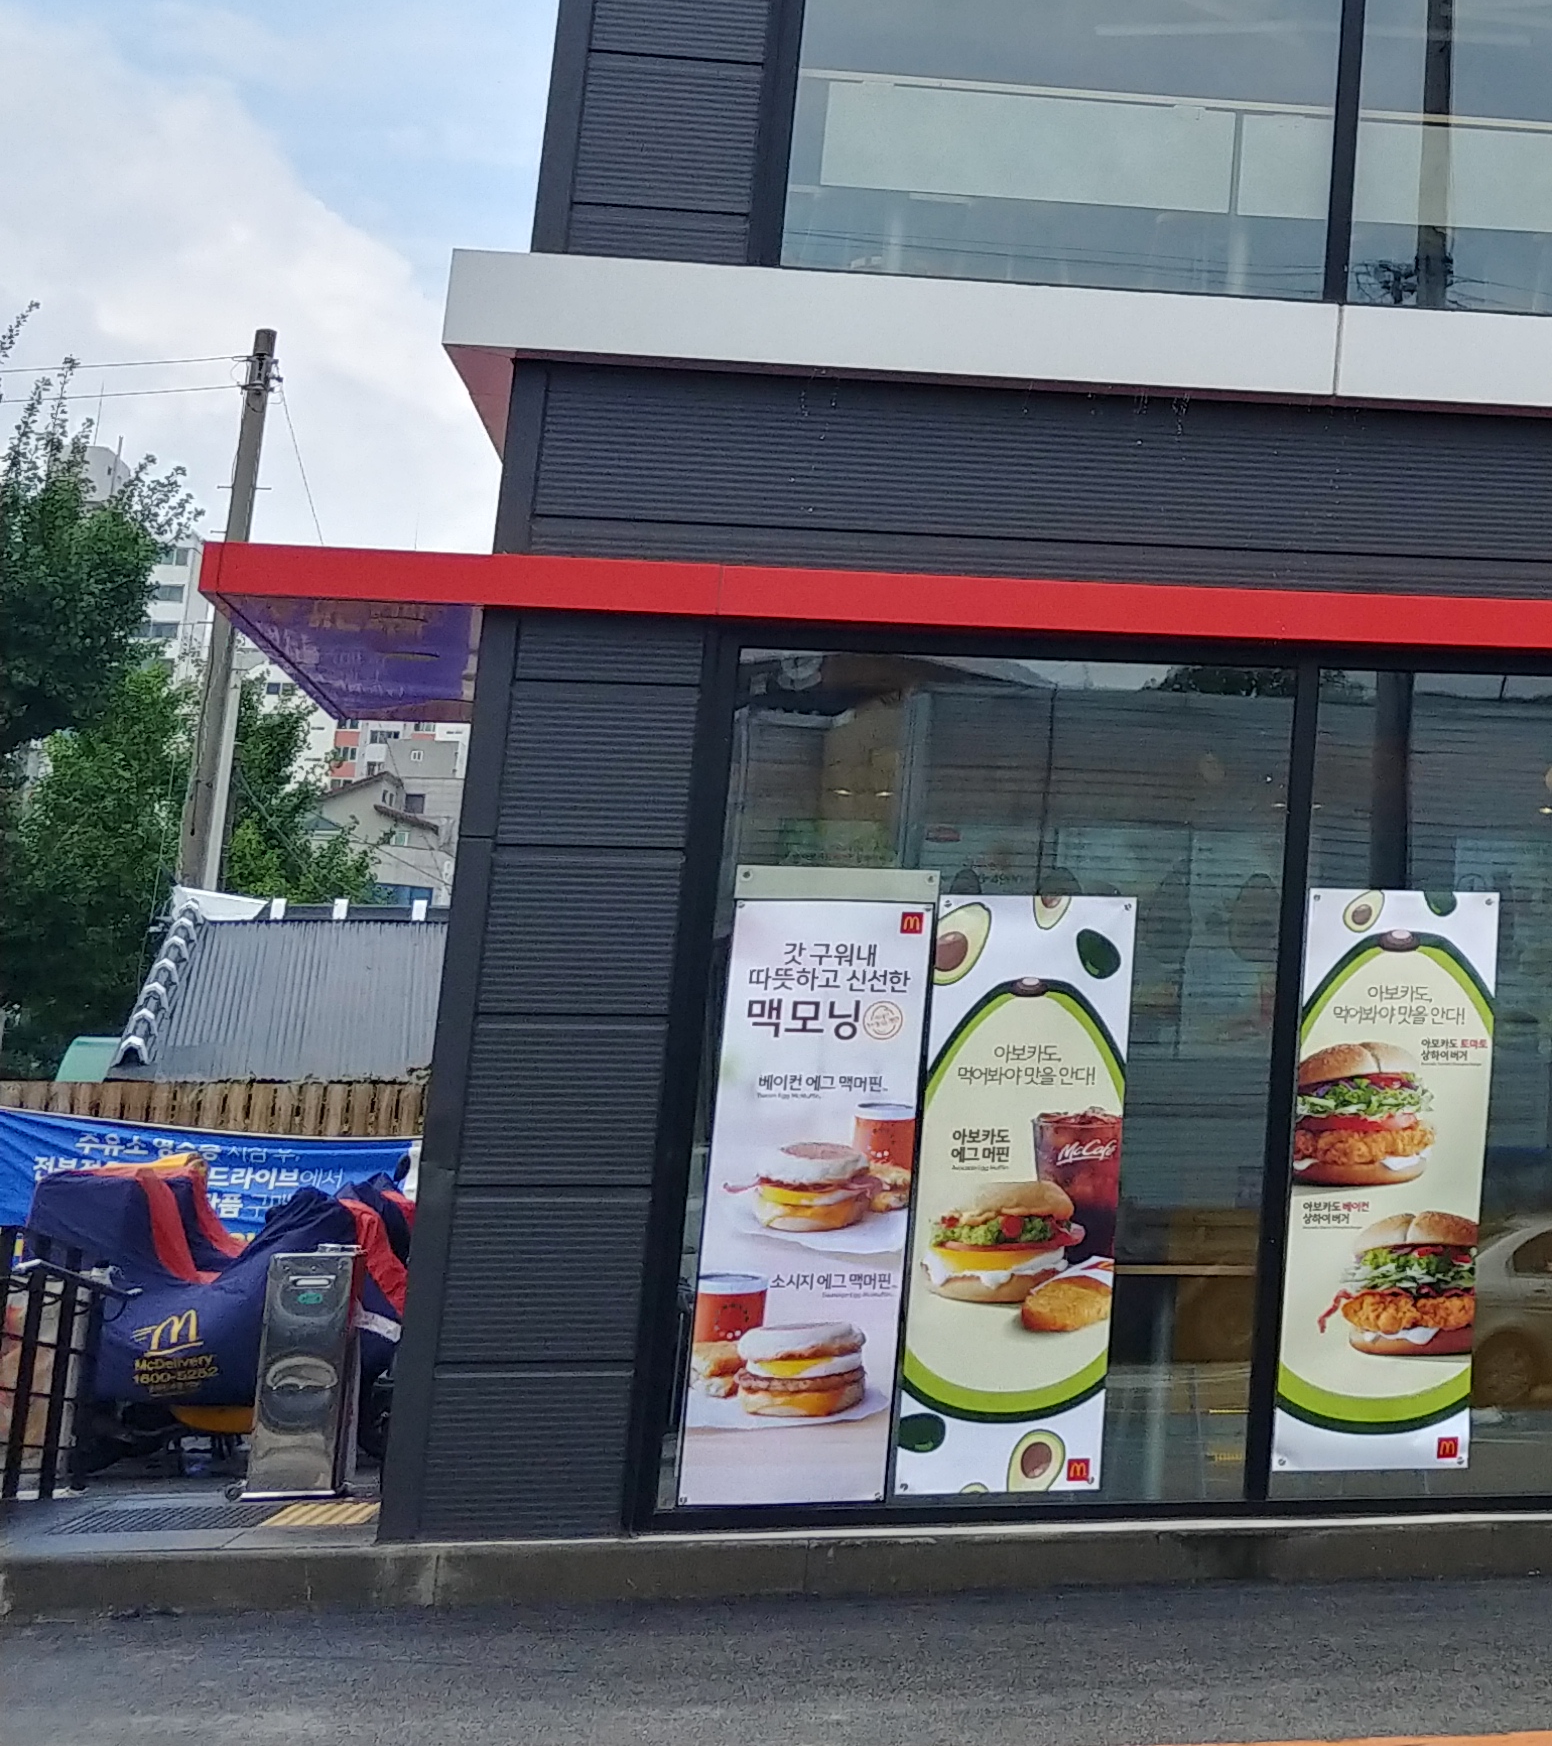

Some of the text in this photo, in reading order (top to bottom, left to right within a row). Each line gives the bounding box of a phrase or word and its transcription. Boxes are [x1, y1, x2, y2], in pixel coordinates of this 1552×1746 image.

[784, 942, 878, 967] 갓 구워내
[749, 967, 911, 993] 따뜻하고 신선한
[1367, 985, 1432, 1003] 아보카도,
[747, 998, 861, 1040] 맥모닝
[1333, 1005, 1466, 1025] 먹어봐야 맛을 안다!
[994, 1044, 1062, 1063] 아보카도,
[758, 1074, 884, 1093] 베이컨 에그 맥머핀
[957, 1066, 1096, 1086] 먹어봐야 맛을 안다!
[75, 1132, 148, 1157] 주유소
[952, 1128, 1011, 1145] 아보카도
[951, 1146, 1011, 1164] 에그 머핀
[770, 1272, 892, 1291] 소시지 에그 맥머핀
[133, 1354, 214, 1371] McDelivery
